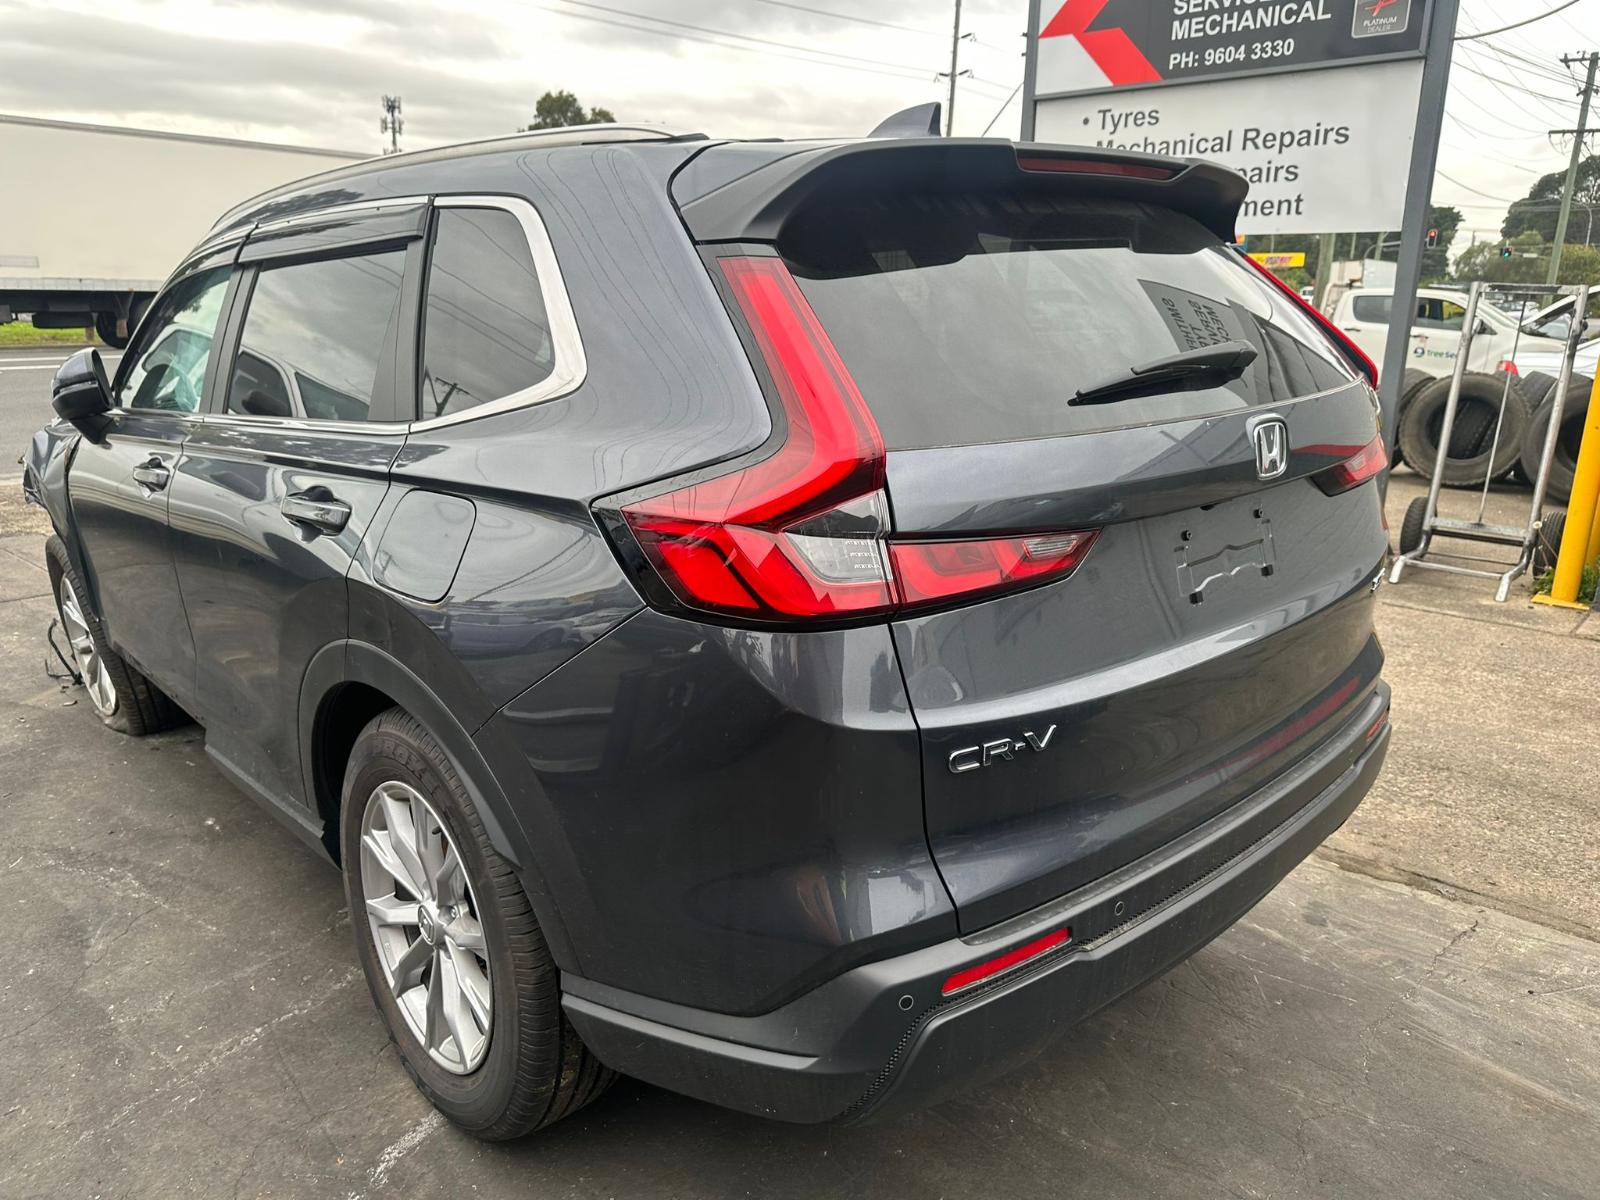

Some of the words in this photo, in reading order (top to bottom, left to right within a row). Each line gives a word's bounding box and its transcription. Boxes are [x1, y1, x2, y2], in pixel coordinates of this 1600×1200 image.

[1171, 0, 1332, 40] MECHANICAL
[1363, 16, 1397, 27] PLATINUM
[1169, 52, 1199, 70] PH:
[1204, 44, 1246, 66] 9604
[1251, 38, 1295, 60] 3330
[1097, 109, 1160, 135] Tyres
[1241, 122, 1350, 154] Repairs
[948, 723, 1057, 773] CR-V
